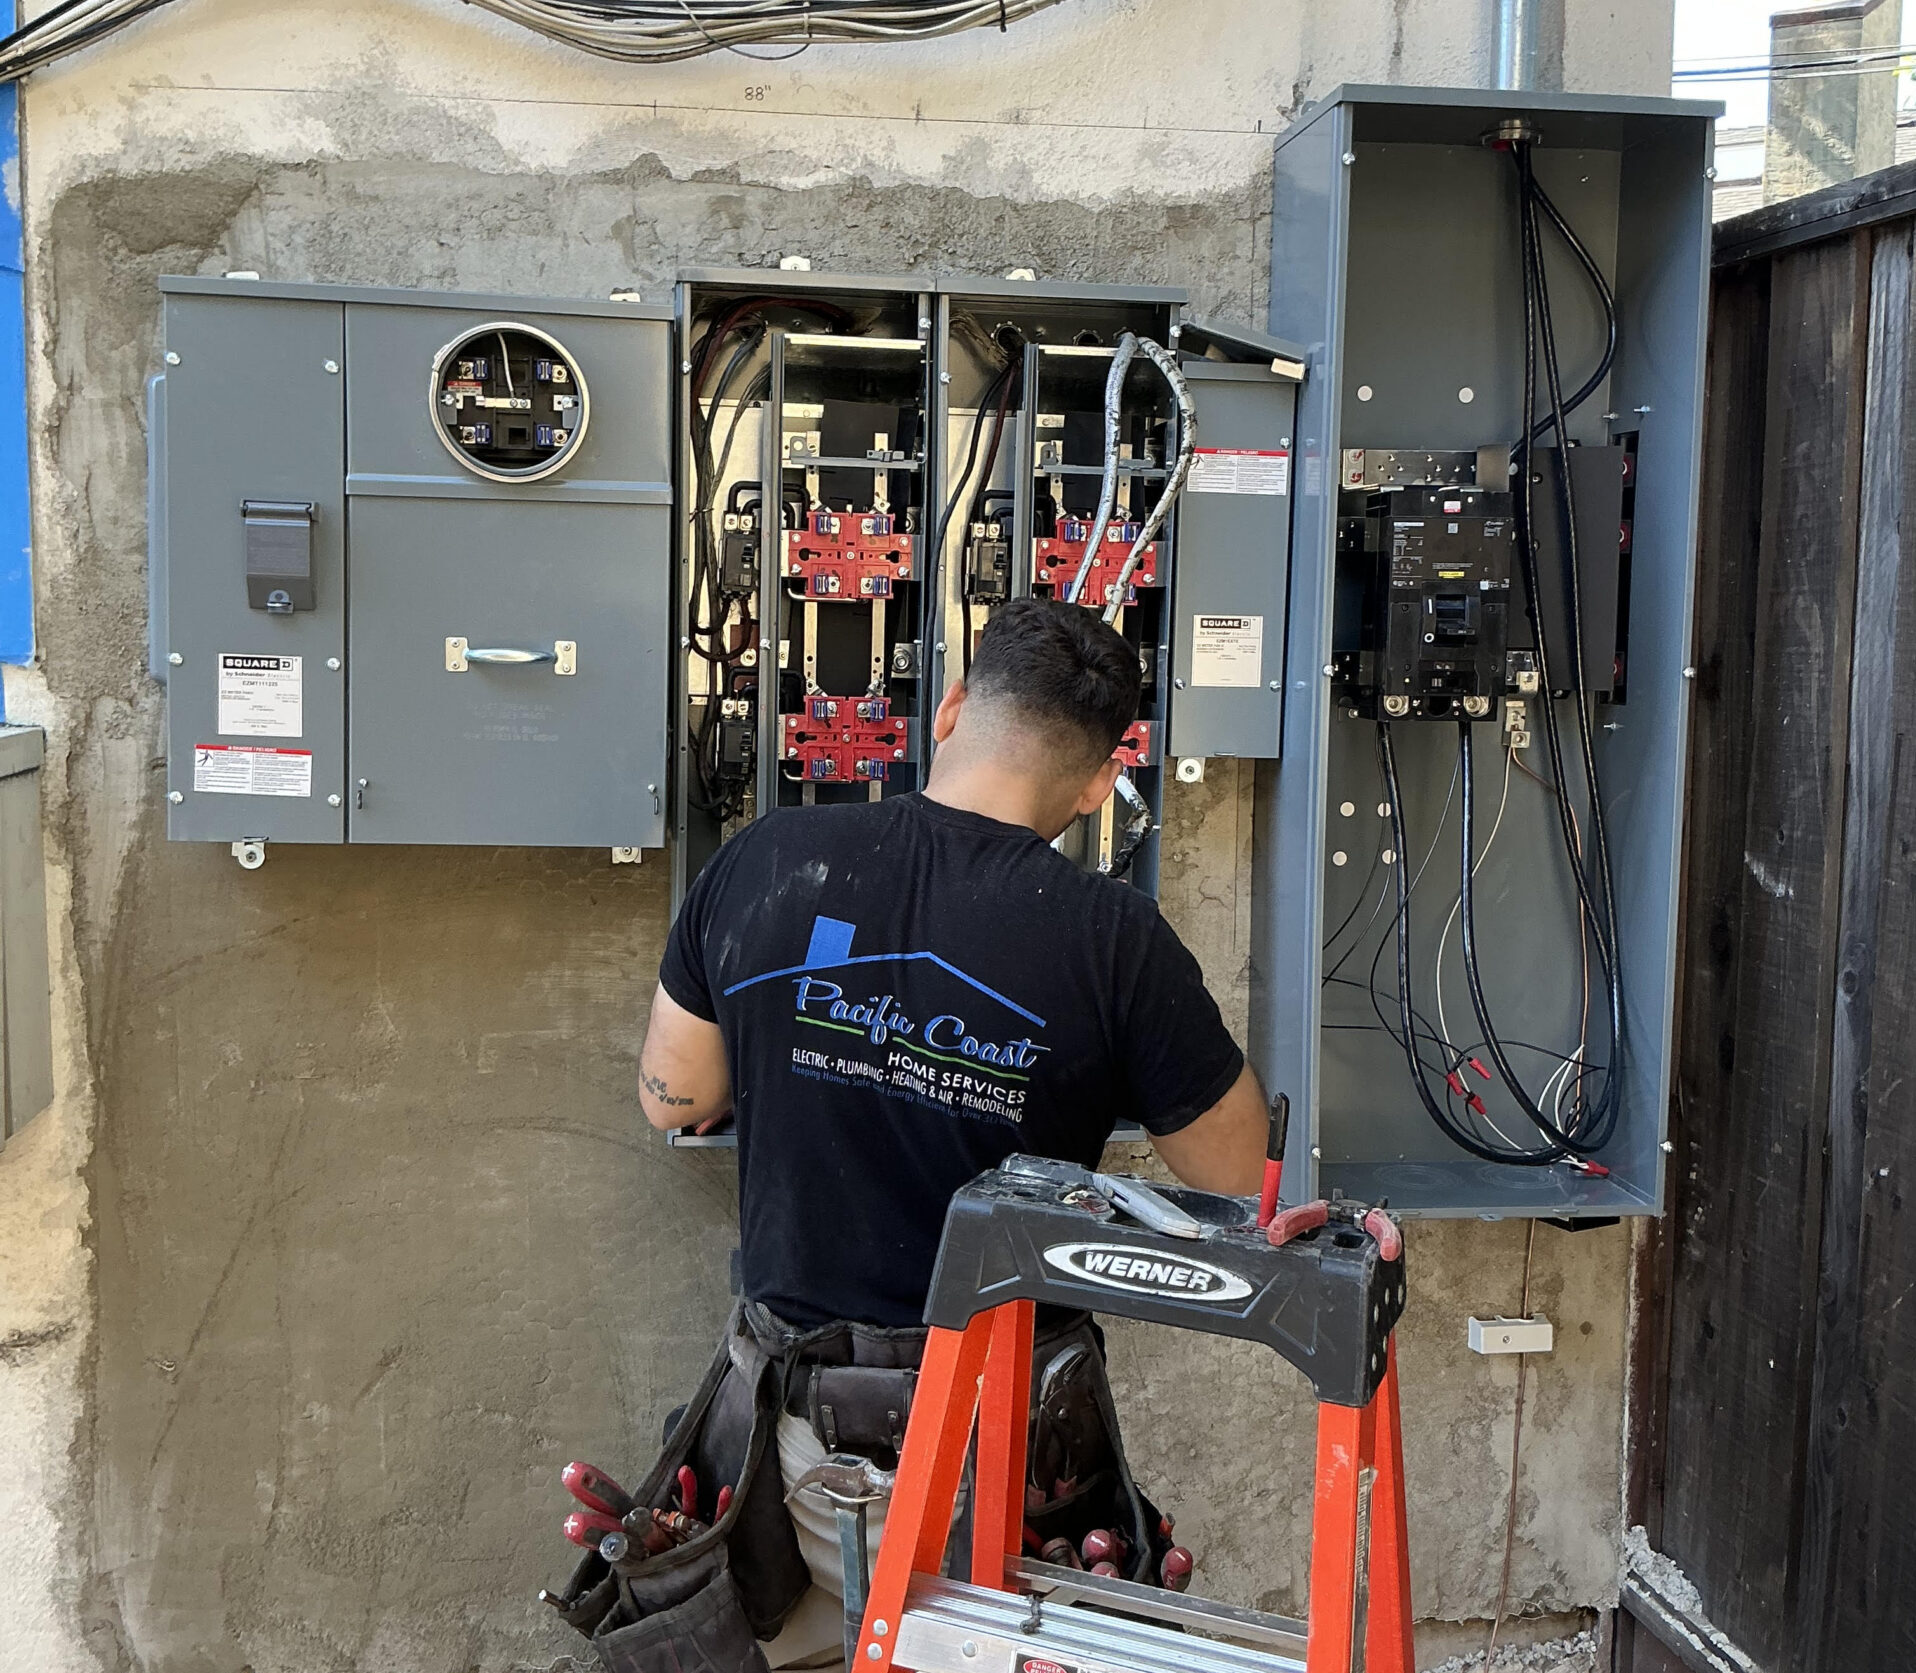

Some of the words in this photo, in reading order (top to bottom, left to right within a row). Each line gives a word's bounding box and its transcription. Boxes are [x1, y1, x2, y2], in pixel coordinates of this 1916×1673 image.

[1201, 619, 1240, 628] SQUARE
[224, 657, 279, 669] SQUARE
[791, 976, 915, 1045] Pacific
[924, 1014, 1051, 1068] Coast
[791, 1063, 821, 1081] Keeping
[822, 1071, 850, 1086] Homes
[792, 1047, 830, 1070] ELECTRIC
[836, 1058, 884, 1082] PLUMBING
[891, 1070, 927, 1095] HEATING
[928, 1085, 936, 1098] &
[938, 1089, 954, 1106] AIR
[961, 1092, 1023, 1123] REMODELING
[887, 1051, 937, 1082] HOME
[940, 1072, 1027, 1104] SERVICES
[1083, 1251, 1215, 1292] WERNER
[1031, 1661, 1061, 1673] DANGER
